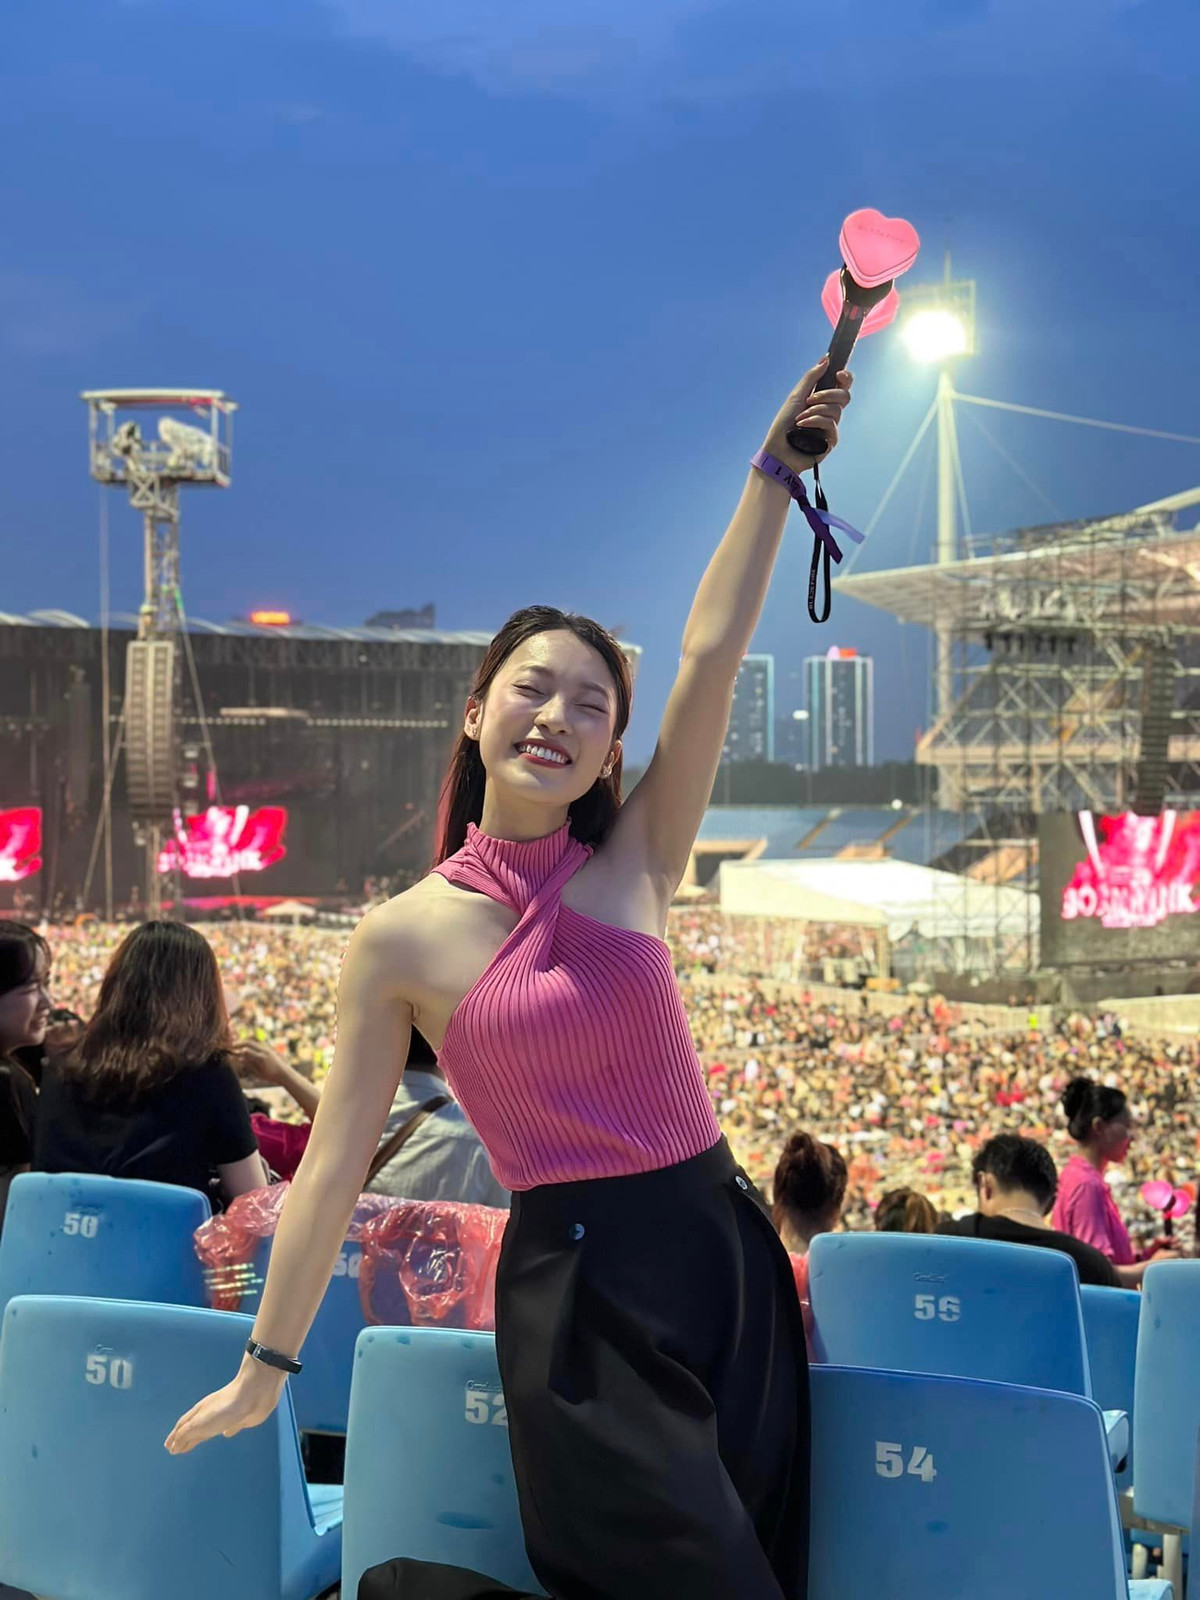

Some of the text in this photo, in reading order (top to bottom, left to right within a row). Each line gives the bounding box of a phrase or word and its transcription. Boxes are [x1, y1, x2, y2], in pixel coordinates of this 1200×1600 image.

[63, 1212, 99, 1238] 50
[914, 1294, 961, 1322] 56
[85, 1355, 133, 1389] 50
[465, 1390, 508, 1425] 52
[875, 1441, 937, 1482] 54
